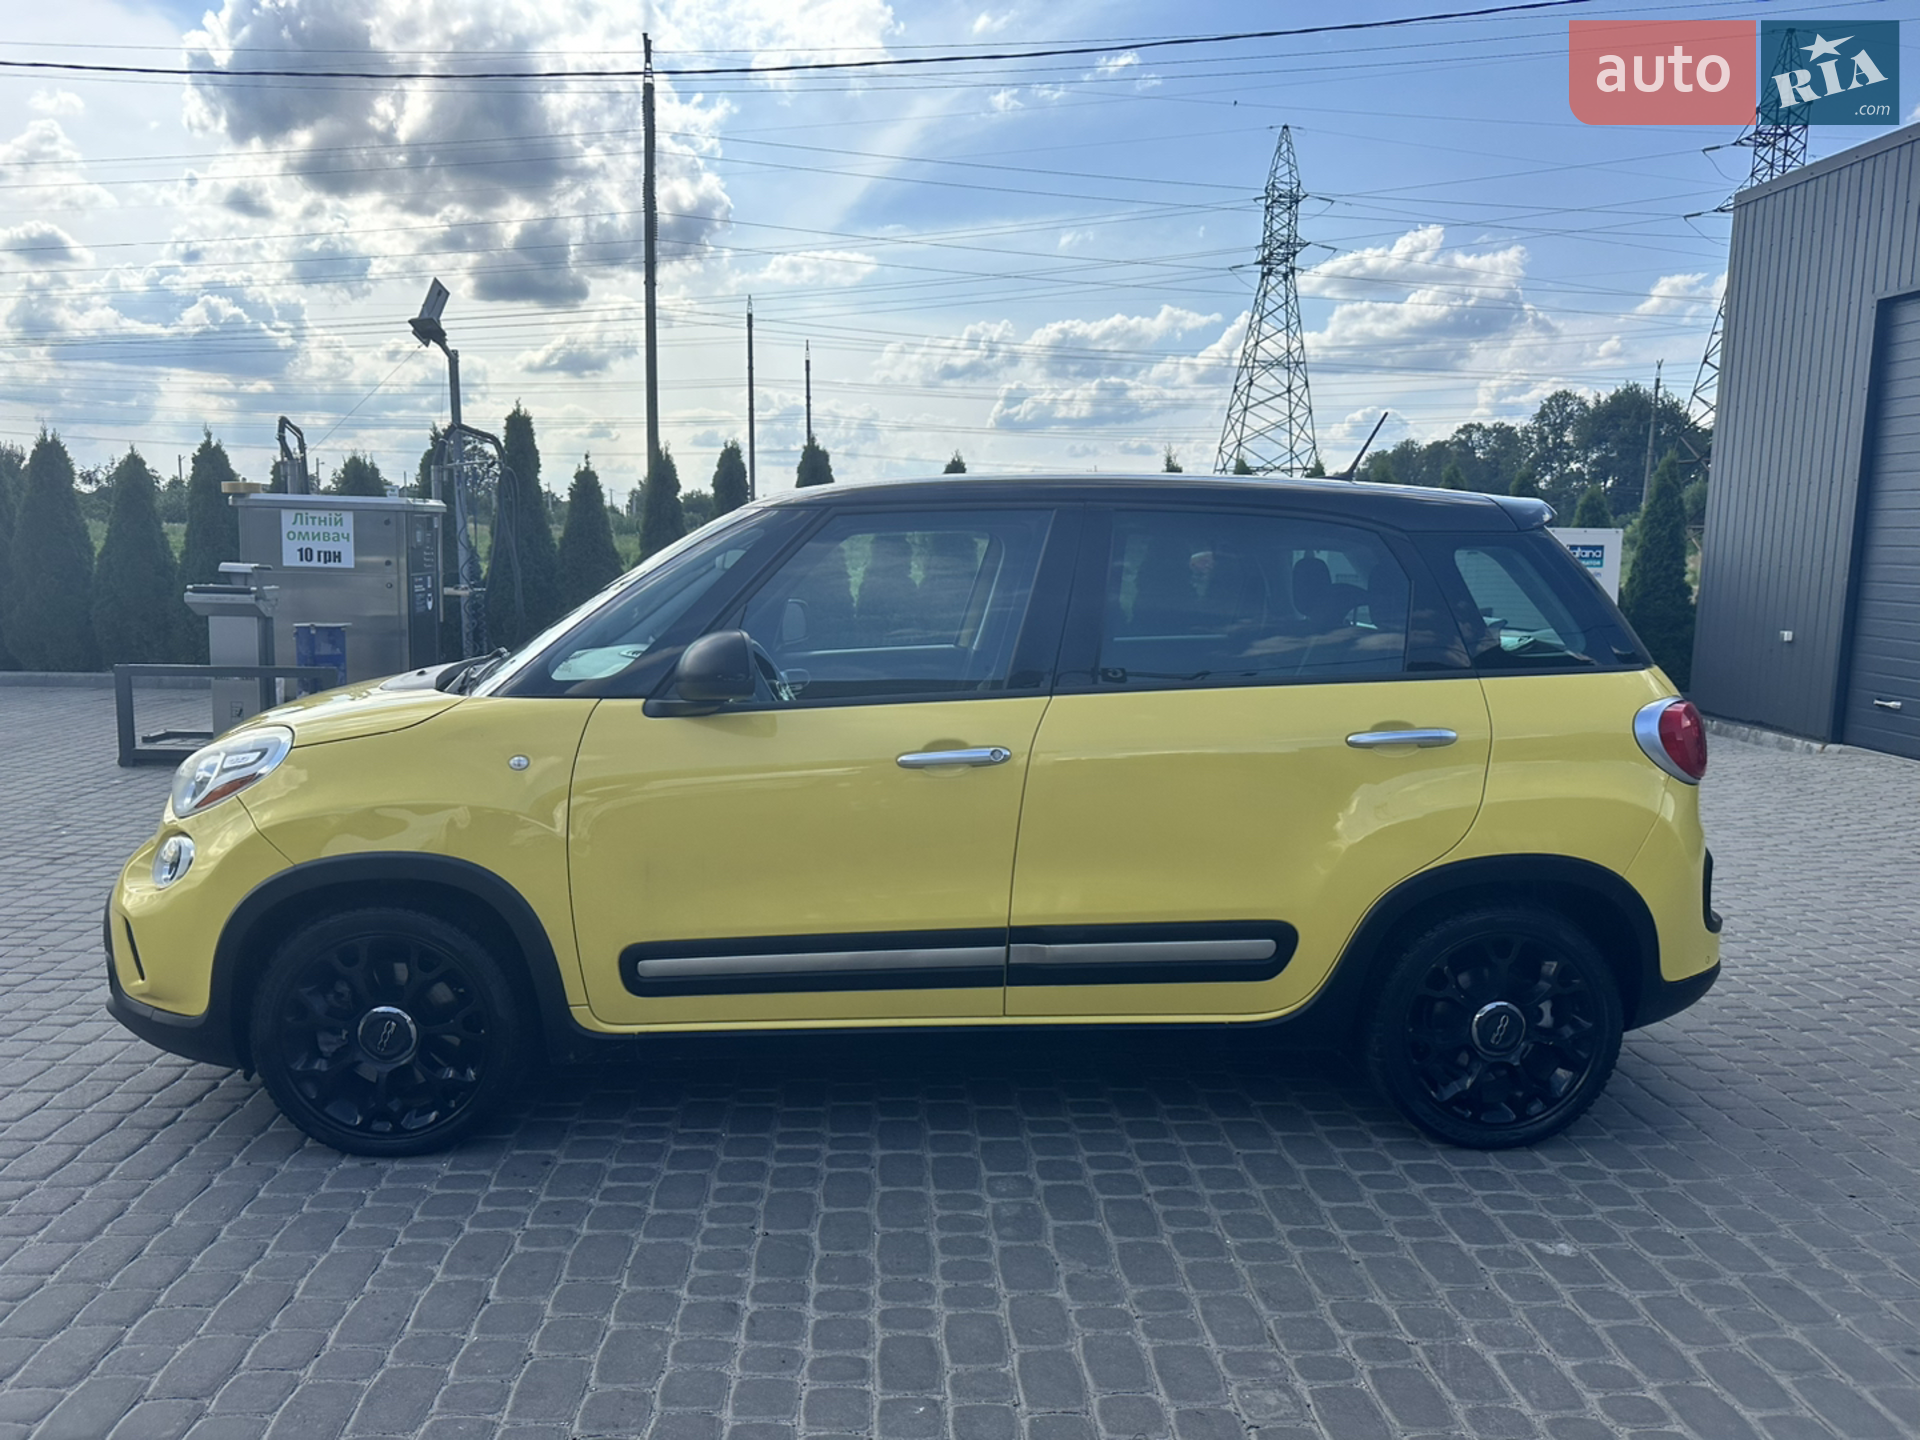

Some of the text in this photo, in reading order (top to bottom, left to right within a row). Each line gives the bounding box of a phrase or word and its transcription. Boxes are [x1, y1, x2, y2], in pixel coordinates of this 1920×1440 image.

[292, 512, 343, 527] Літній
[286, 530, 350, 542] омивач
[297, 547, 341, 564] 10 грн
